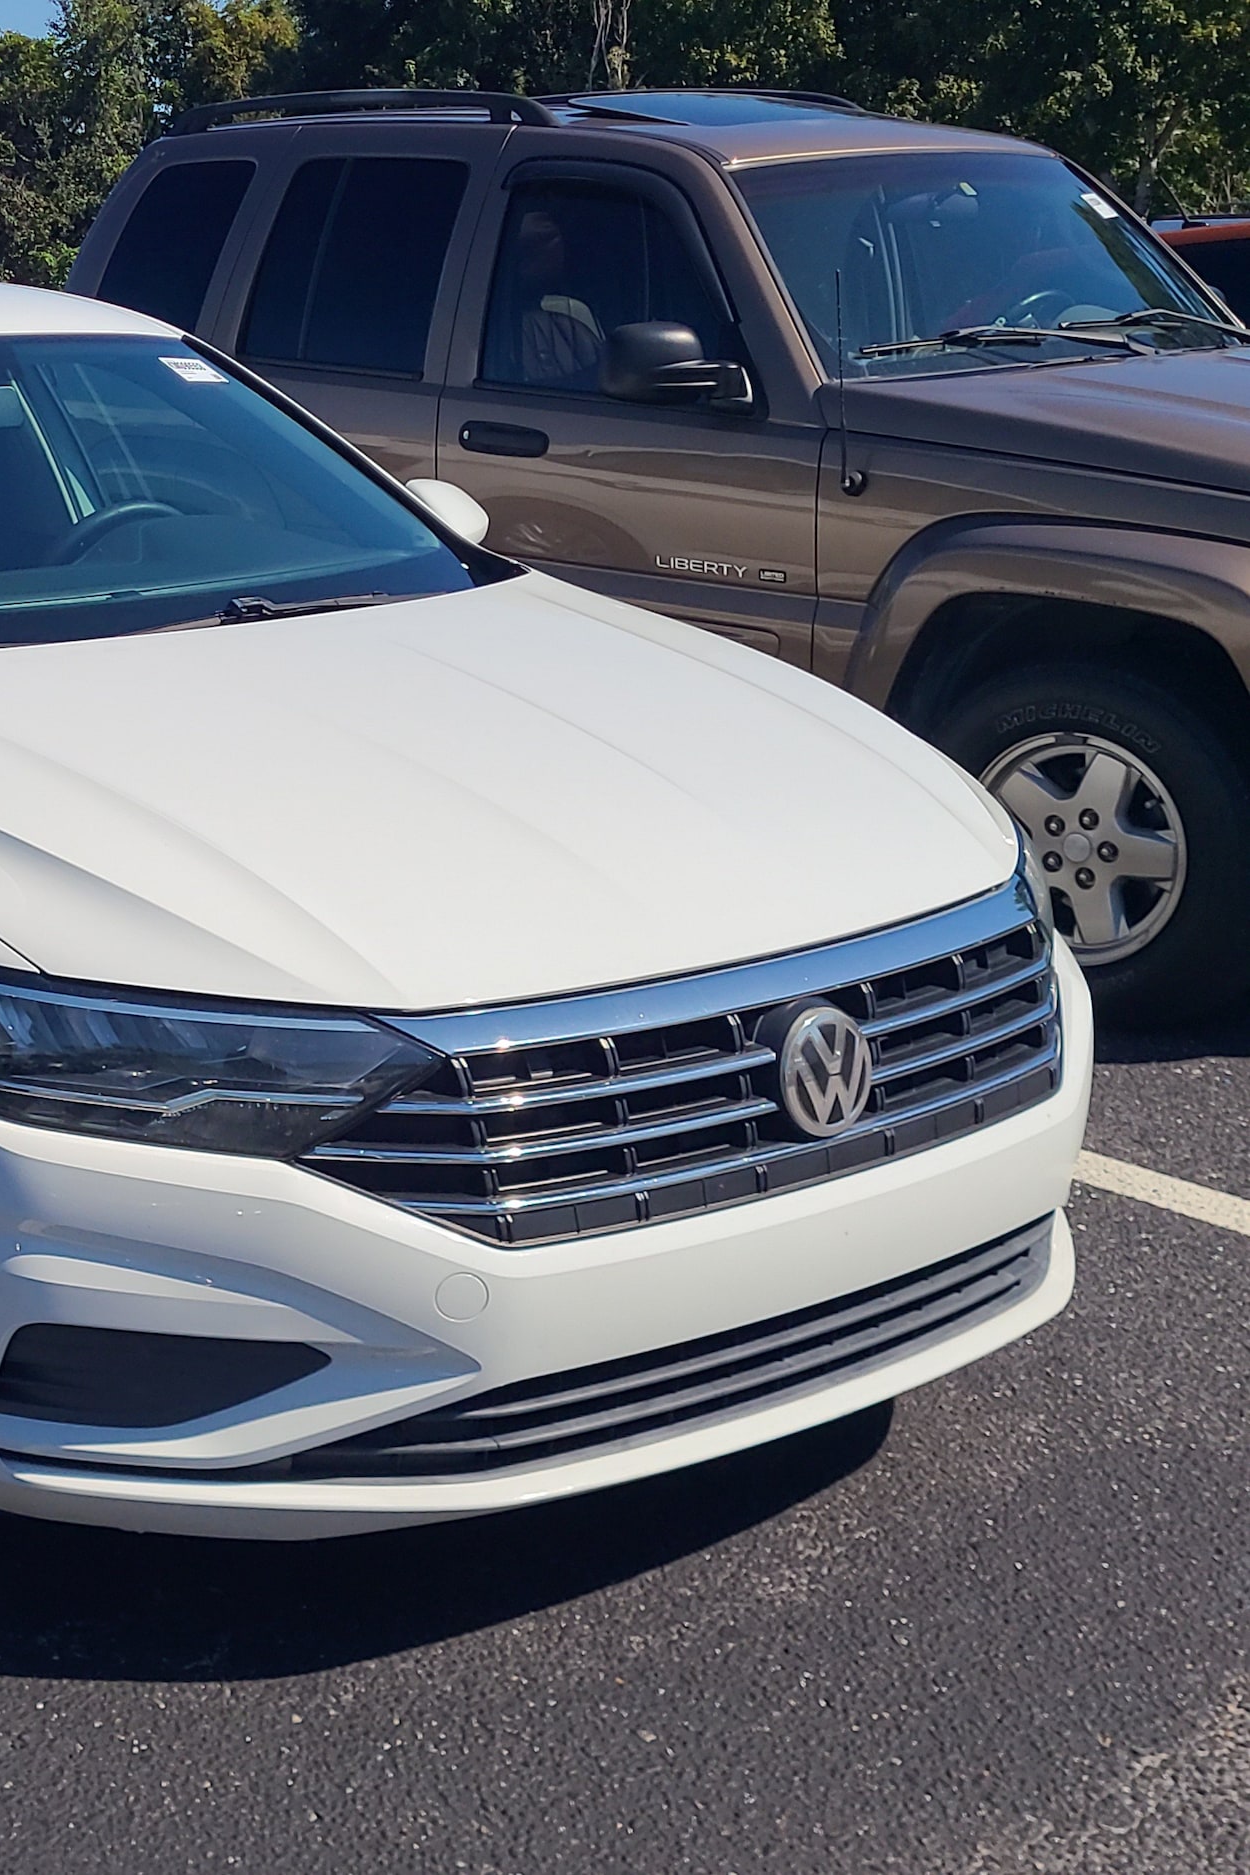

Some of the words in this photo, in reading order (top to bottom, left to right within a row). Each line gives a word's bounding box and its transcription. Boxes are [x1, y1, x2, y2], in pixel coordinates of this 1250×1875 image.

[655, 555, 748, 578] LIBERTY
[995, 703, 1161, 754] MICHELIN
[783, 1010, 869, 1134] VW
